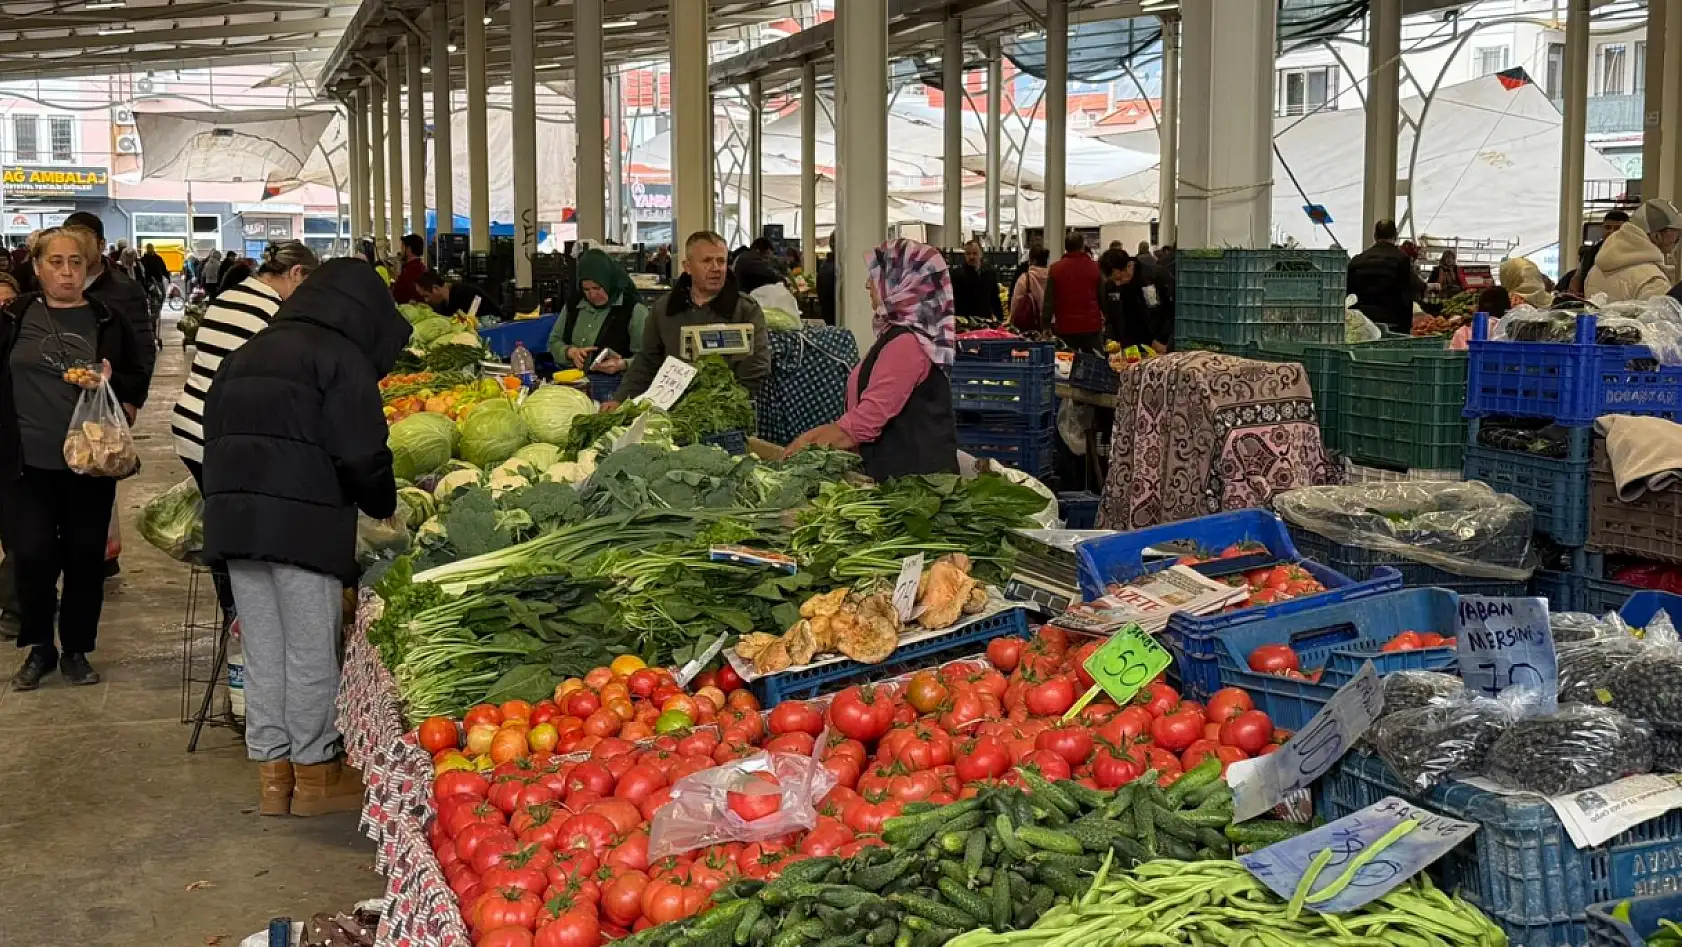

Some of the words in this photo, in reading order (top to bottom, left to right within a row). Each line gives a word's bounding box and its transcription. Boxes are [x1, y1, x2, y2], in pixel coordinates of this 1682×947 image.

[30, 171, 106, 184] AMBALAJ
[1459, 601, 1514, 628] YABAN
[1103, 649, 1148, 687] 50
[1292, 710, 1342, 774] 100
